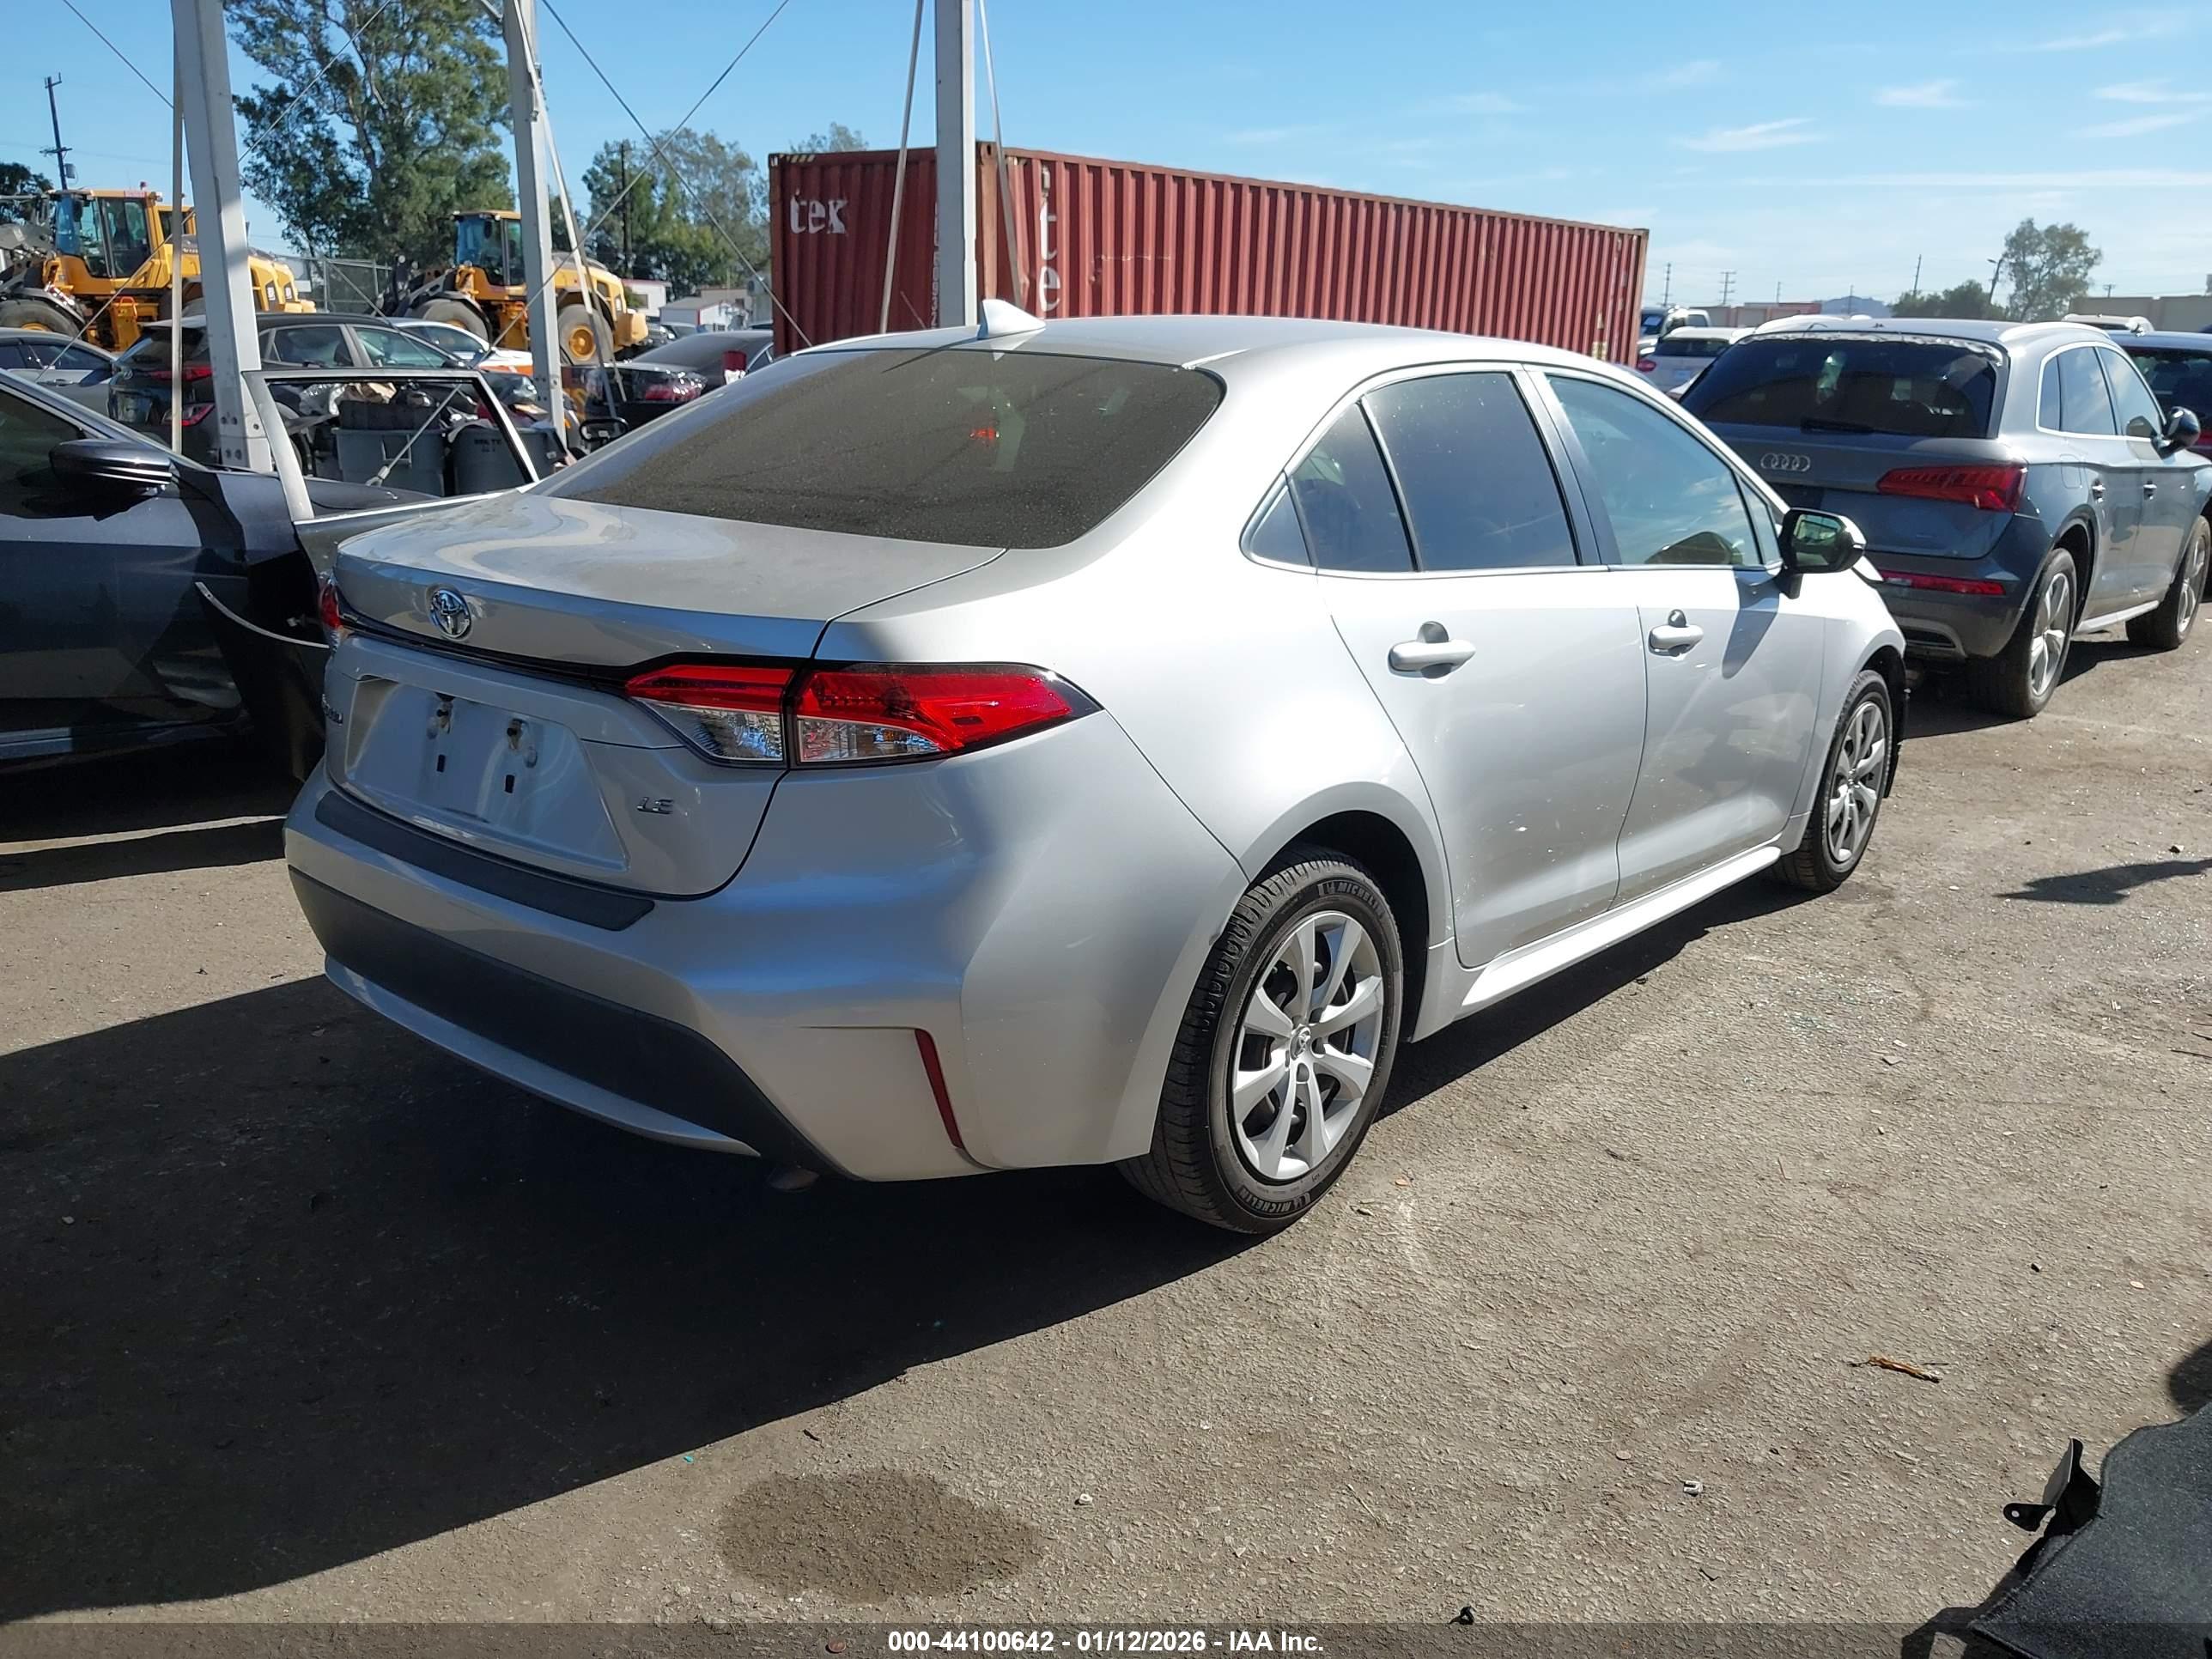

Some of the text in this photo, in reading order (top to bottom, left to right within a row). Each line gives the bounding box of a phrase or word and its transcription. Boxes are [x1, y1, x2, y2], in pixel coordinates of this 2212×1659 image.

[789, 188, 848, 235] tex
[636, 796, 673, 815] LE
[1337, 881, 1386, 920] MICHELIN
[1237, 1185, 1291, 1213] MICHELIN
